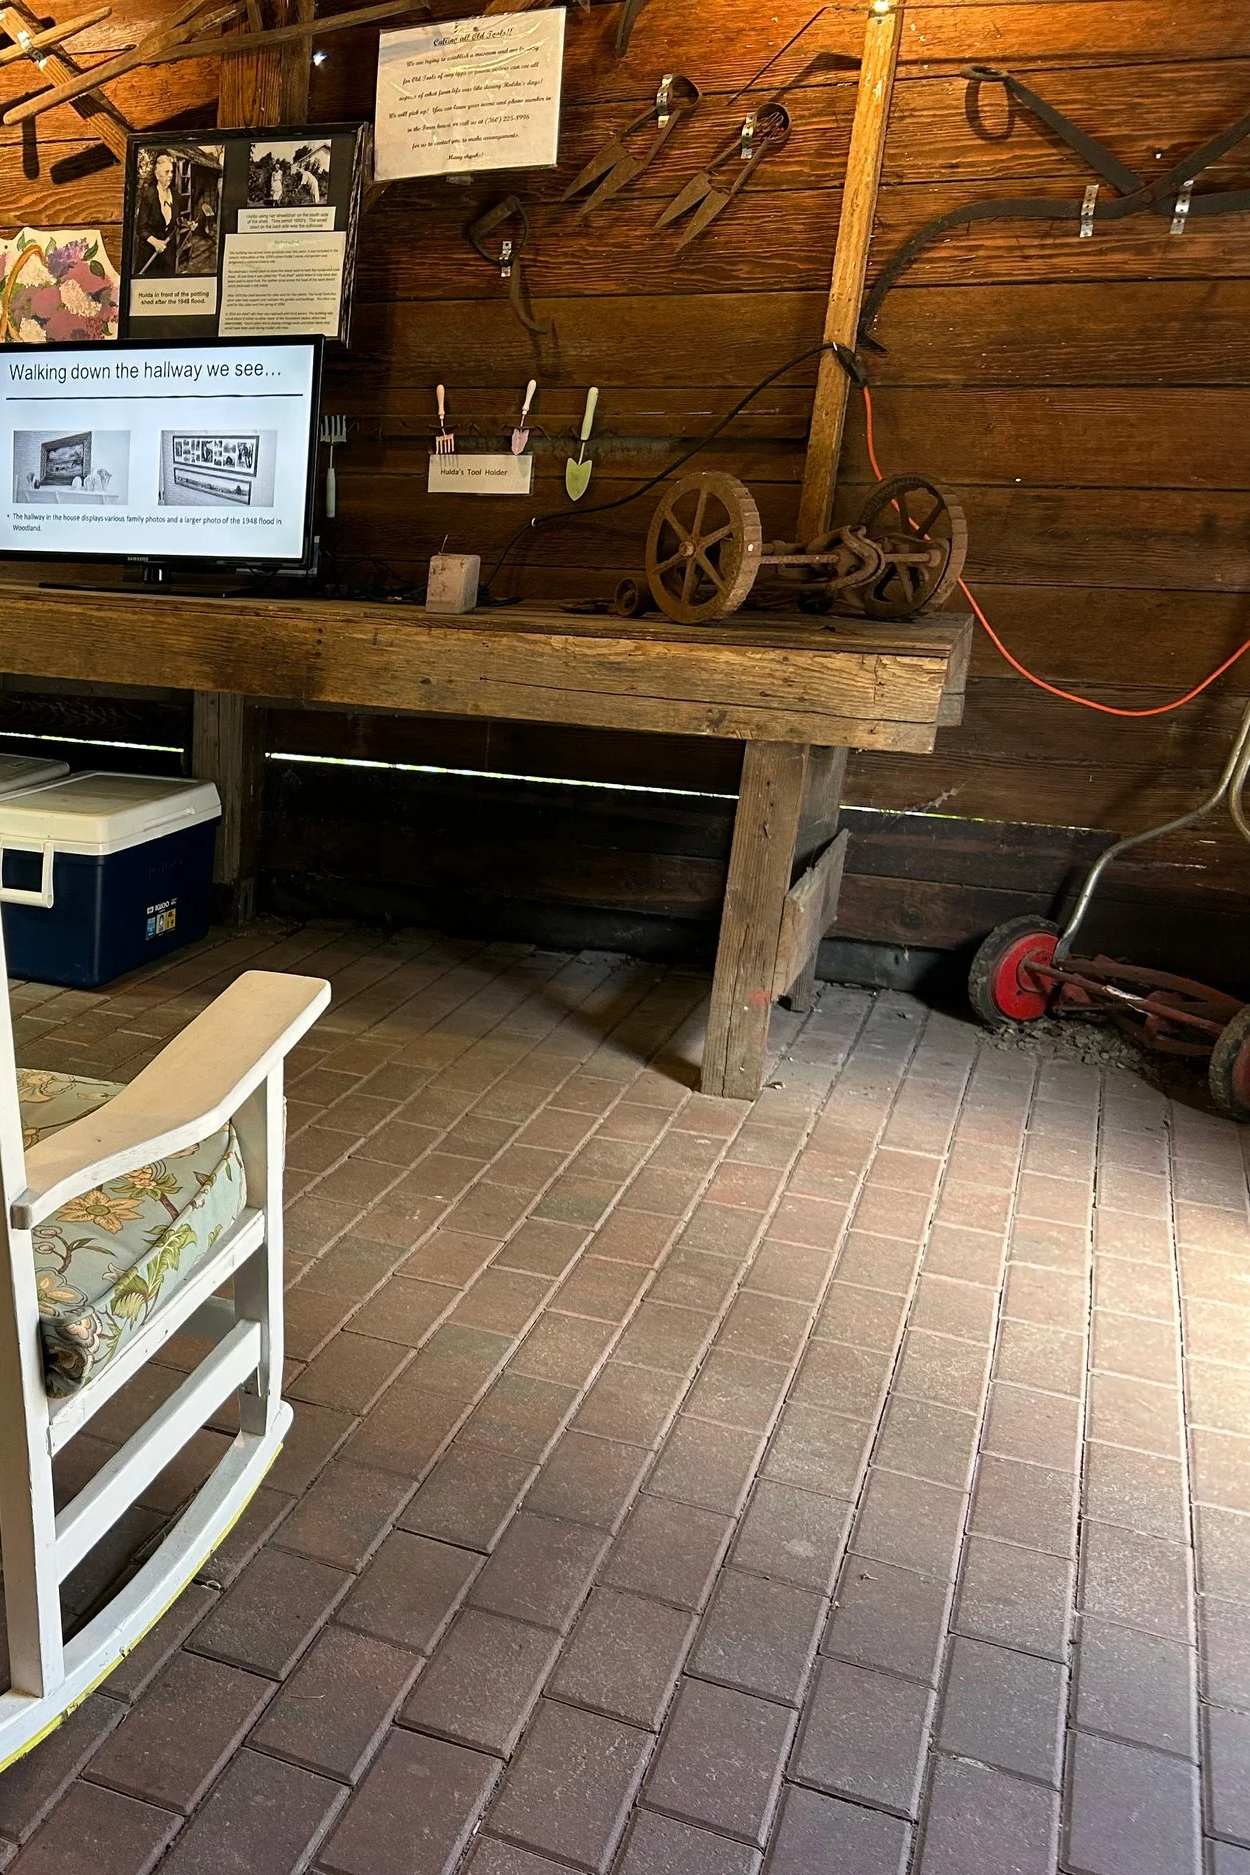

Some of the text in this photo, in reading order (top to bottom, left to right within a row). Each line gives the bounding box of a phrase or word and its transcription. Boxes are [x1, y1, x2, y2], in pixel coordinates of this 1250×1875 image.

[460, 34, 470, 42] all
[472, 31, 484, 40] Old
[527, 78, 543, 86] days!
[408, 110, 418, 118] pick
[432, 106, 442, 114] You
[9, 363, 67, 384] Walking
[71, 362, 111, 380] down
[116, 361, 139, 379] the
[144, 361, 202, 381] hallway
[206, 364, 229, 377] we
[24, 513, 45, 521] hallway
[81, 514, 104, 523] displays
[127, 515, 144, 524] family
[145, 516, 166, 524] photos
[184, 517, 202, 525] larger
[203, 517, 221, 525] photo
[13, 524, 42, 532] Woodland.
